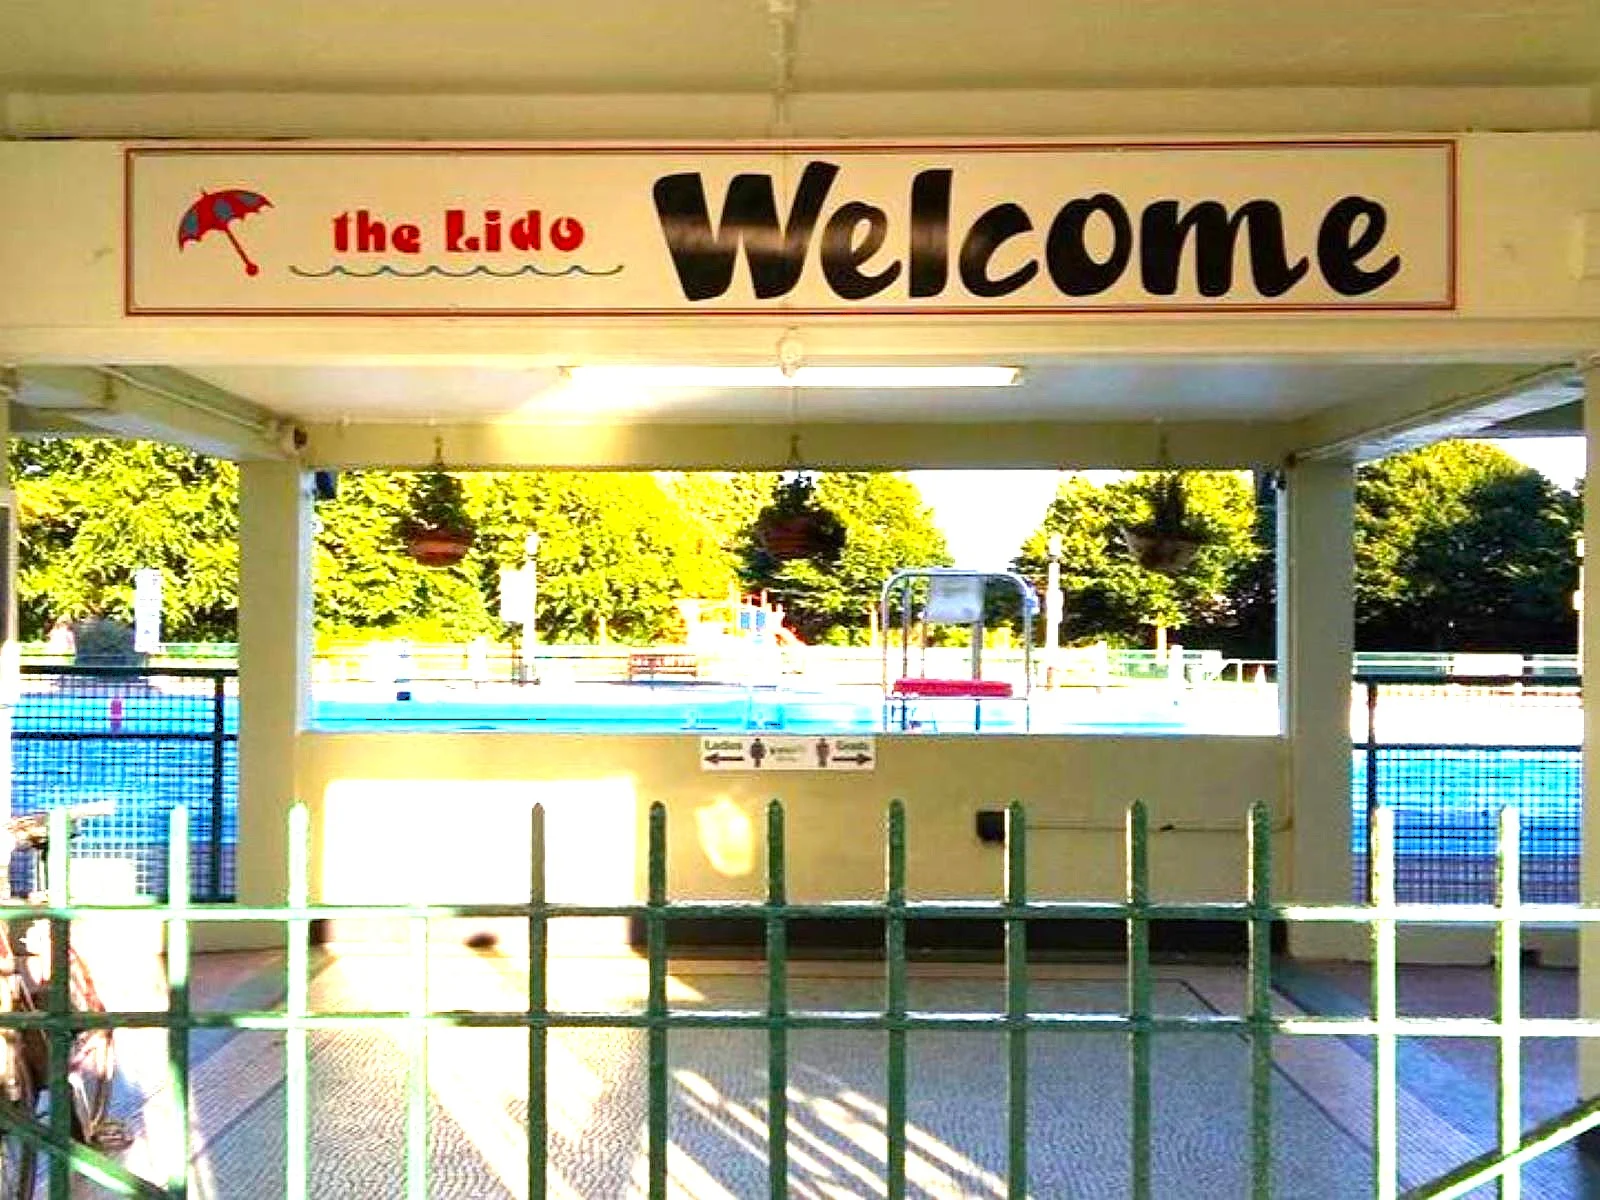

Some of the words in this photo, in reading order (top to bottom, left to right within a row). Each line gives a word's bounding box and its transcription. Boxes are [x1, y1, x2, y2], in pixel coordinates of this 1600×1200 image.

[333, 210, 421, 254] the
[445, 210, 584, 254] Lido
[653, 161, 1401, 302] Welcome
